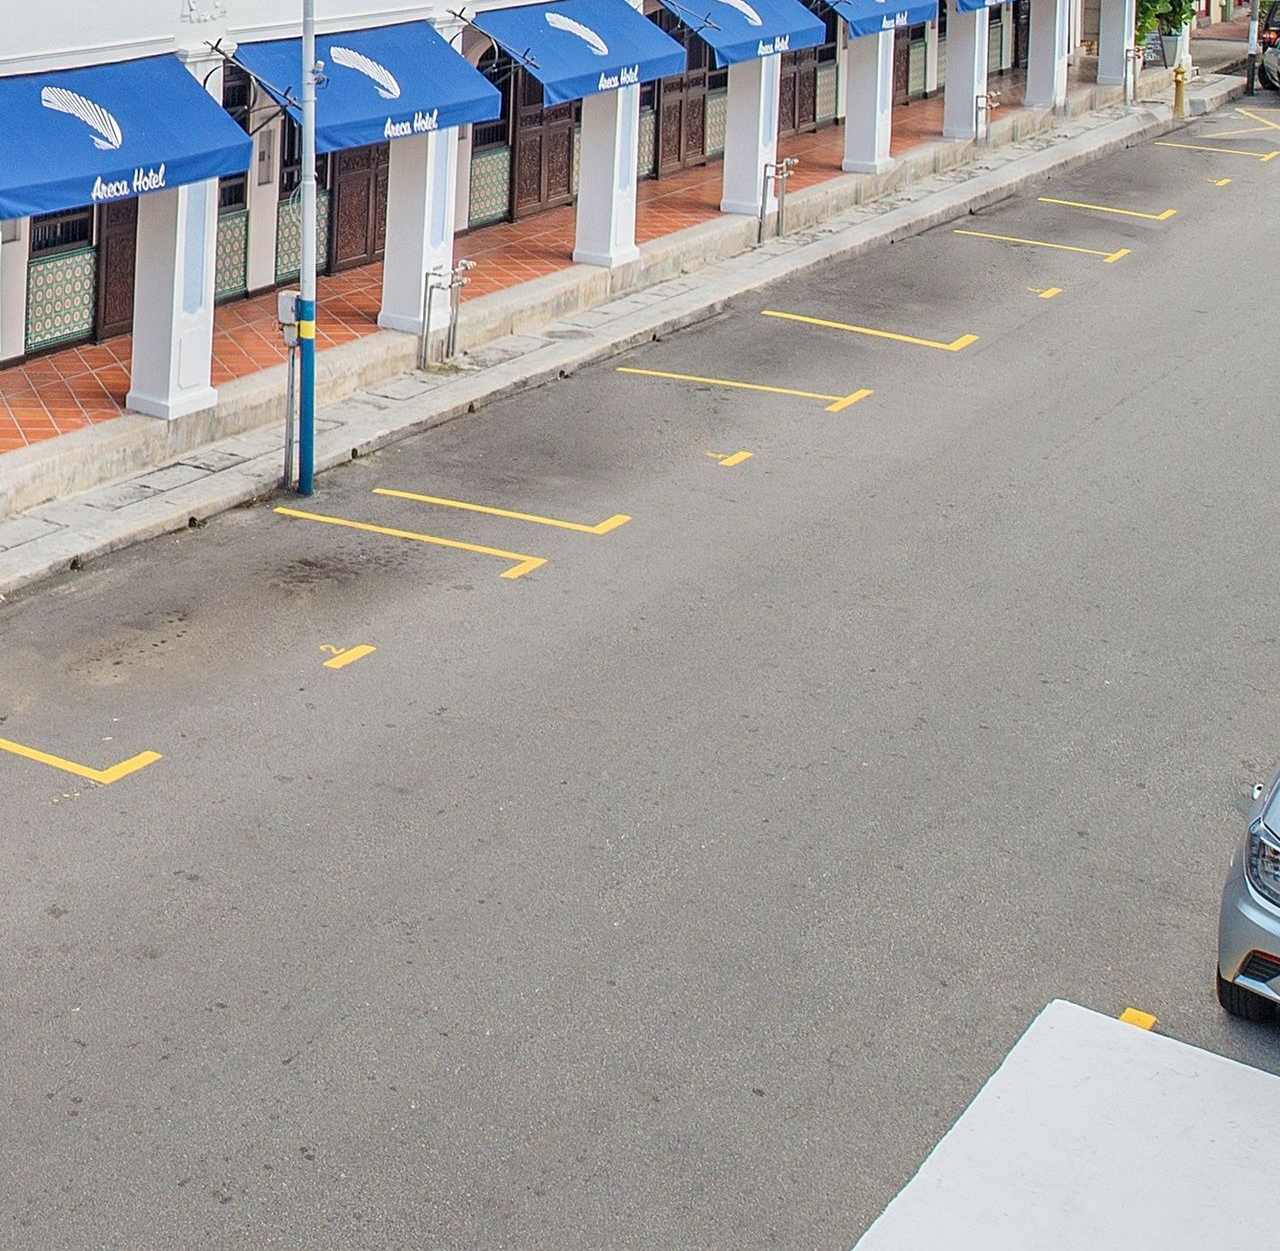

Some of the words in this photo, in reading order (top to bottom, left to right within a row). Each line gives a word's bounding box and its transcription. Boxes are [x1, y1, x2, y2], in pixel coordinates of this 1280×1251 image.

[384, 117, 412, 139] Areca
[413, 108, 438, 133] Hotel
[91, 175, 130, 201] Areca
[132, 162, 166, 192] Hotel
